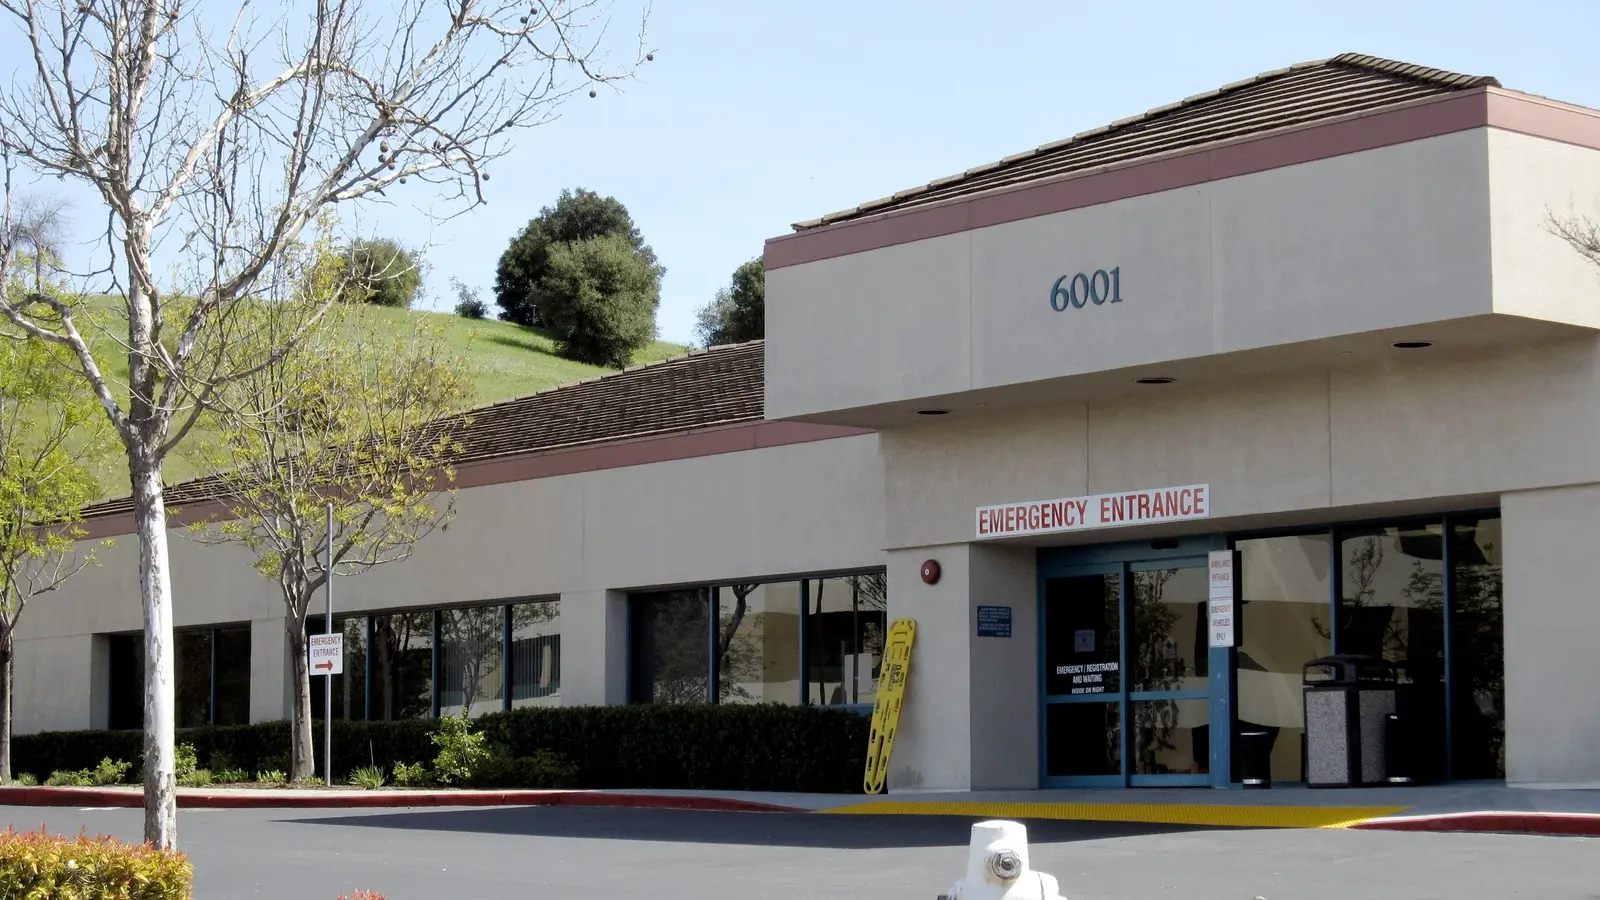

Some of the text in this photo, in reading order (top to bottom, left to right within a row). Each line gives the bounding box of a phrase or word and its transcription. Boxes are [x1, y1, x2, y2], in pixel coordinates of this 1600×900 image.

[1050, 266, 1123, 312] 6001
[979, 487, 1204, 535] EMERGENCY ENTRANCE
[1211, 572, 1230, 581] ENTRANCE
[1210, 605, 1232, 613] EMERGENCY
[1212, 618, 1230, 627] VEHICLES
[311, 636, 341, 646] EMERGENCY
[313, 647, 339, 657] ENTRANCE
[1087, 662, 1118, 672] REGISTRATION
[1072, 674, 1102, 684] AND WAITING
[1071, 687, 1085, 695] INSIDE
